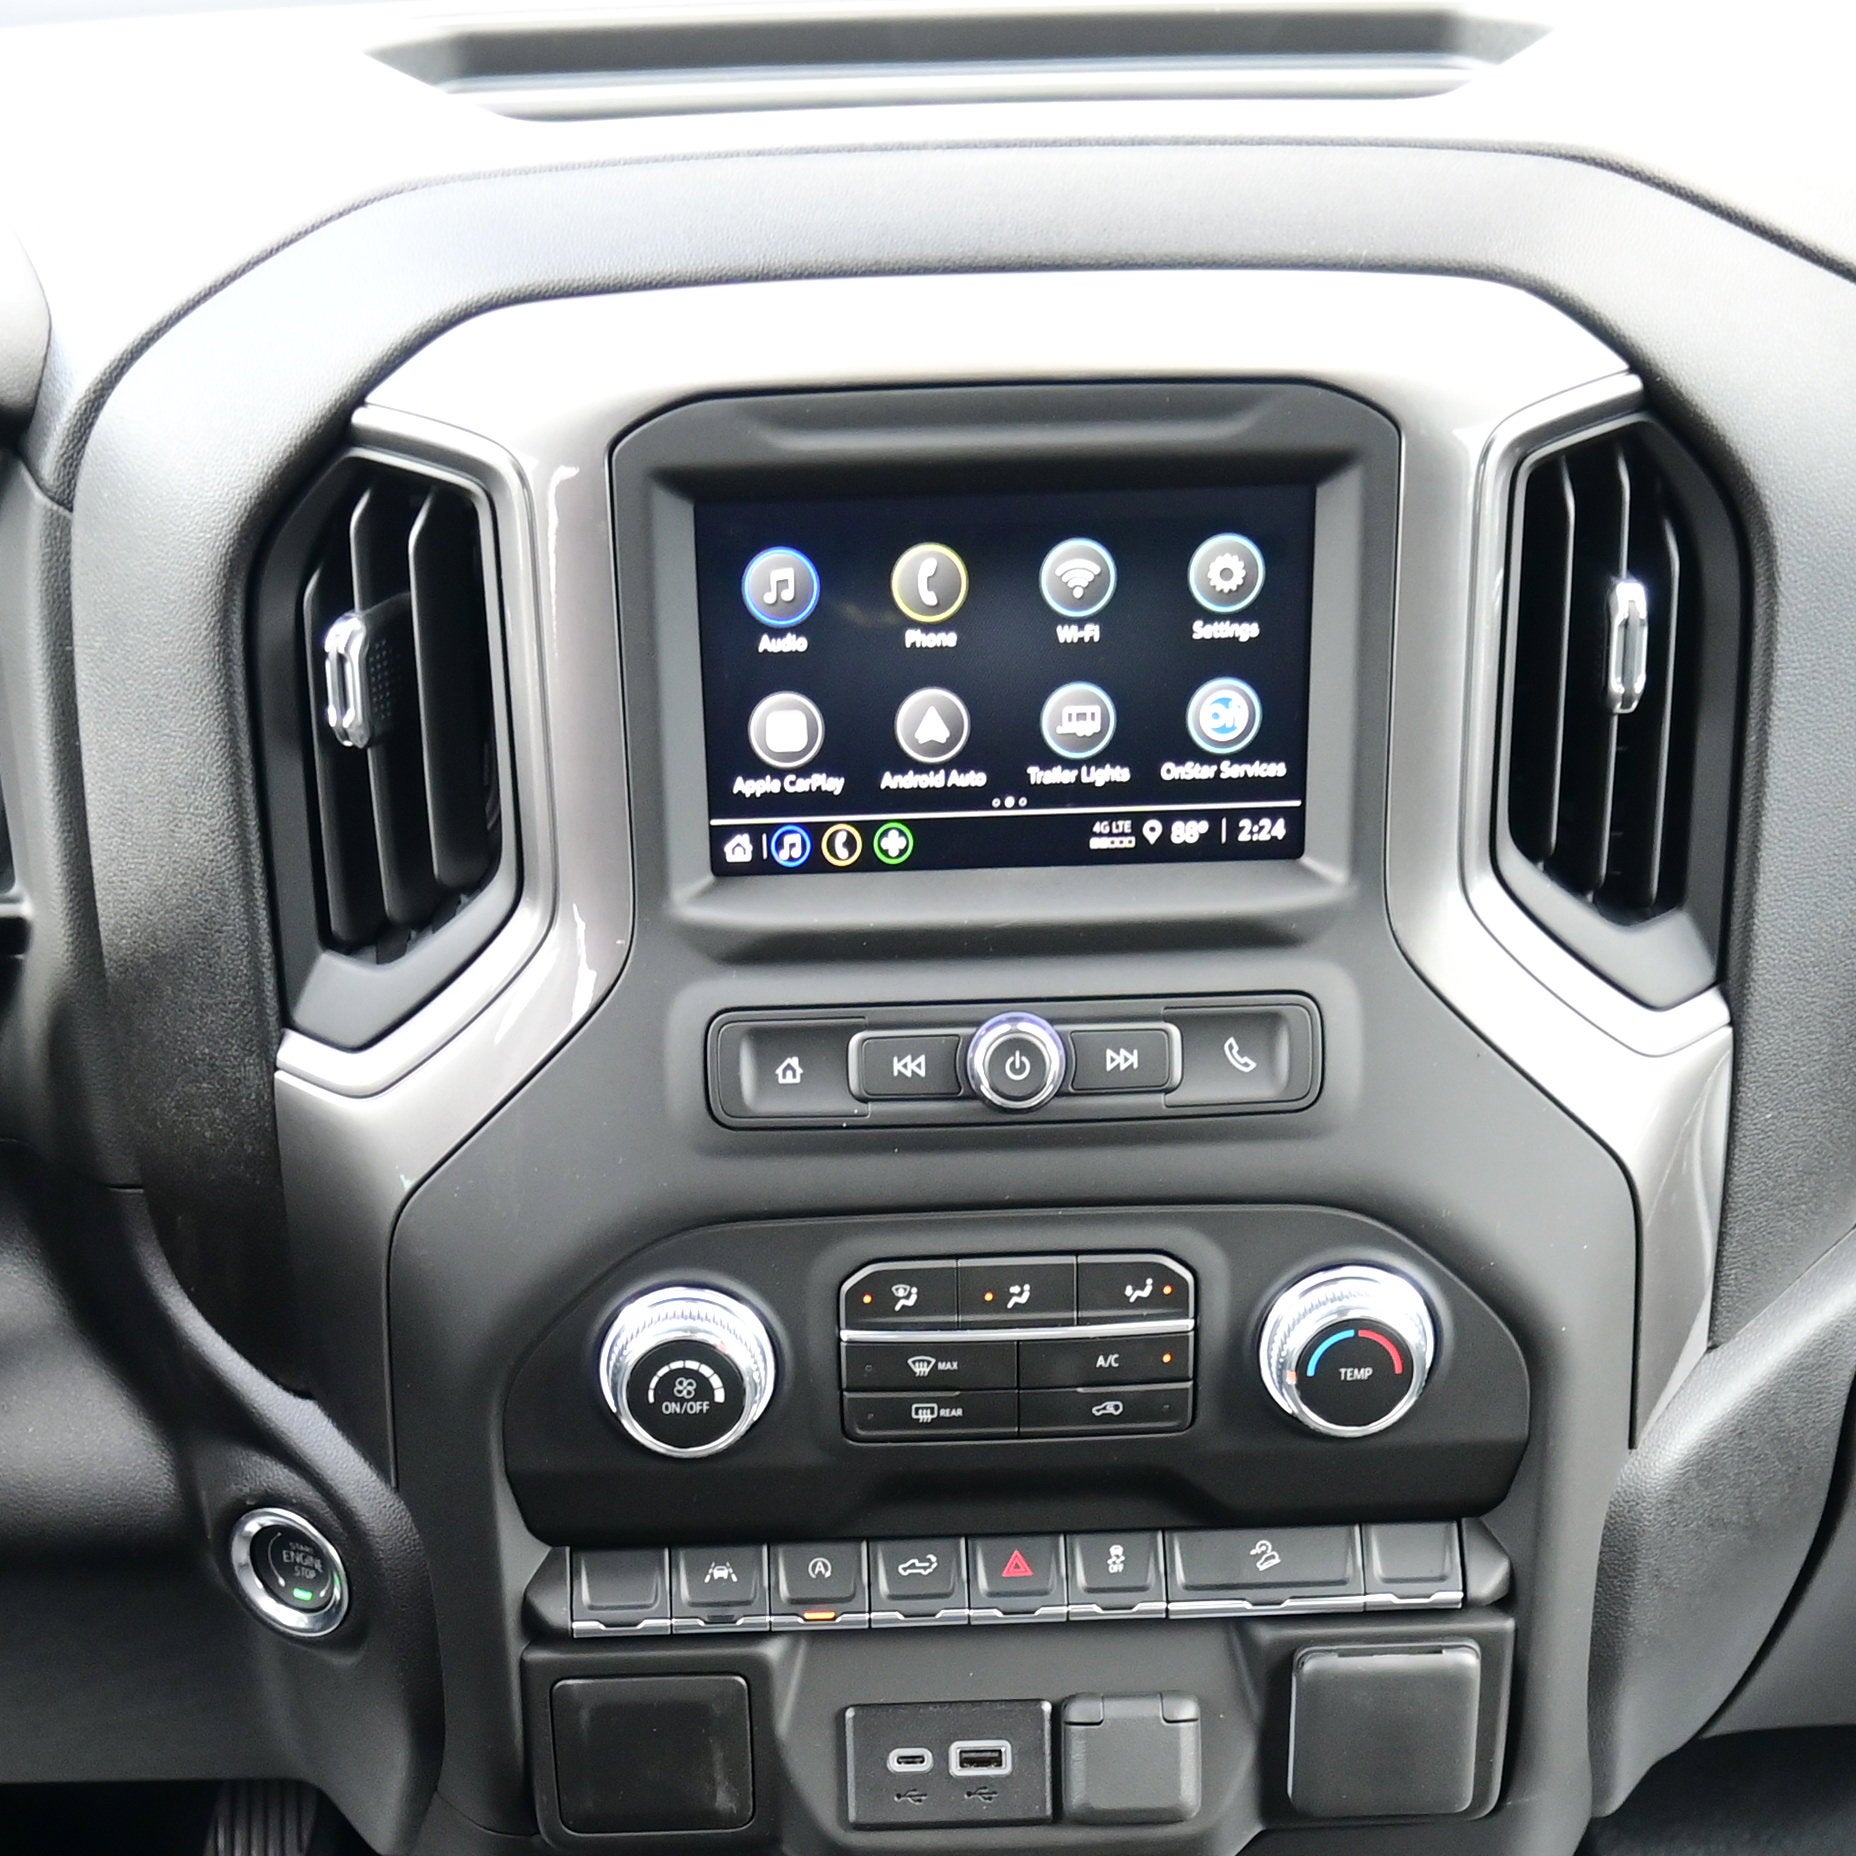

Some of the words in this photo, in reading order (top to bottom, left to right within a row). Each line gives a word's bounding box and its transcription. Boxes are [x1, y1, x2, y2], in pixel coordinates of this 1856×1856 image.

[904, 628, 958, 649] Phone
[1055, 623, 1101, 643] Wi-Fi
[1191, 619, 1260, 643] Settings
[758, 633, 808, 653] Audio
[880, 769, 946, 791] Android
[947, 768, 987, 789] Auto
[1026, 764, 1079, 785] Trailer
[1080, 763, 1131, 787] Lights
[1160, 761, 1218, 781] OnStar
[1219, 760, 1287, 780] Services
[732, 774, 781, 798] Apple
[783, 772, 846, 796] CarPlay
[1092, 820, 1111, 834] 4G
[1112, 820, 1133, 834] LTE
[1237, 817, 1287, 842] 2:24
[937, 1361, 959, 1371] MAX
[1095, 1353, 1120, 1368] A/C
[1339, 1367, 1374, 1380] TEMP
[661, 1401, 711, 1415] ON/OFF
[939, 1407, 963, 1418] REAR
